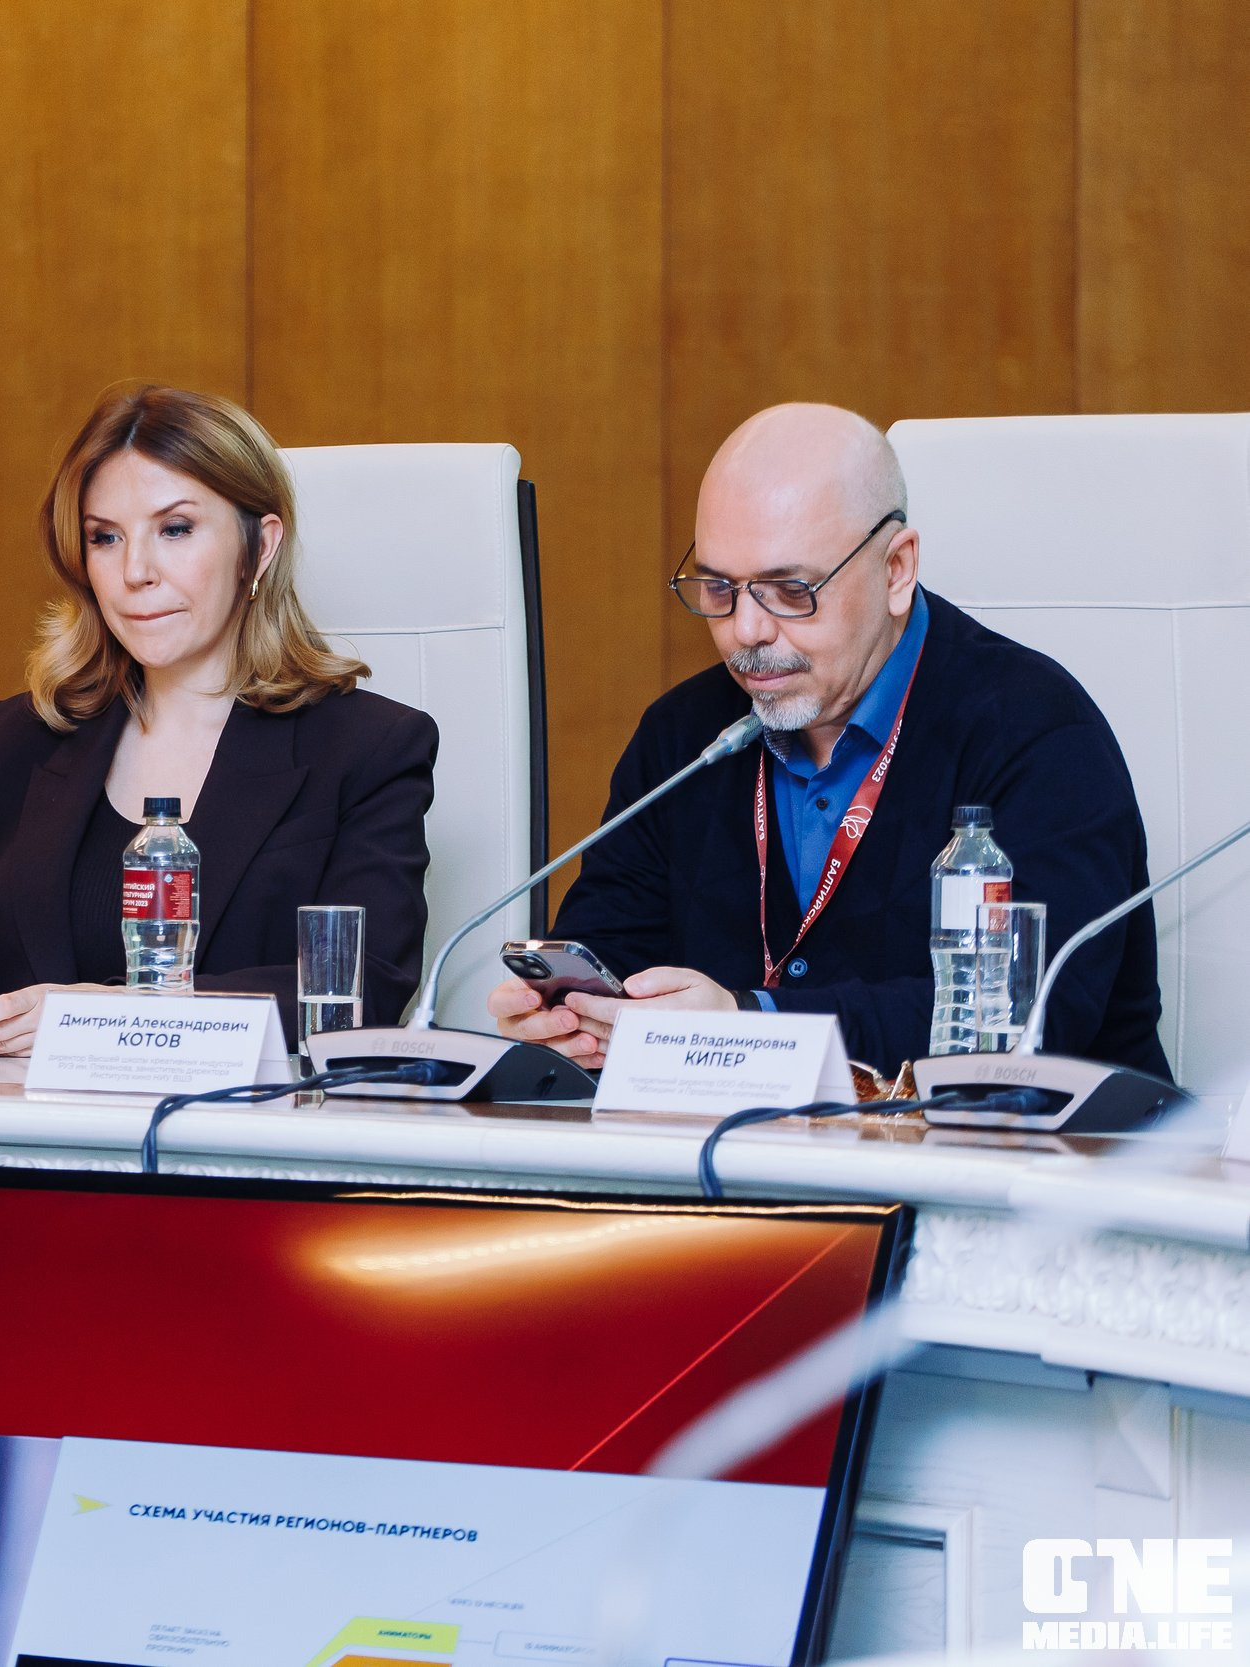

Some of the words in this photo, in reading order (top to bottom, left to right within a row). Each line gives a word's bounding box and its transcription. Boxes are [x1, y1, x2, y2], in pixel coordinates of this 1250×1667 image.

[871, 754, 891, 782] 2023
[58, 1014, 127, 1029] Дмитрий
[130, 1016, 249, 1032] Александрович
[117, 1032, 182, 1048] КОТОВ
[391, 1041, 436, 1055] BOSCH
[644, 1032, 686, 1046] Елена
[689, 1033, 796, 1051] Владимировна
[683, 1051, 746, 1067] КИПЕР
[993, 1066, 1037, 1081] BOSCH
[129, 1503, 187, 1521] СХЕМА
[192, 1508, 271, 1527] УЧАСТИЯ
[275, 1515, 478, 1543] РЕГИОНОВ-ПАРТНЕРОВ
